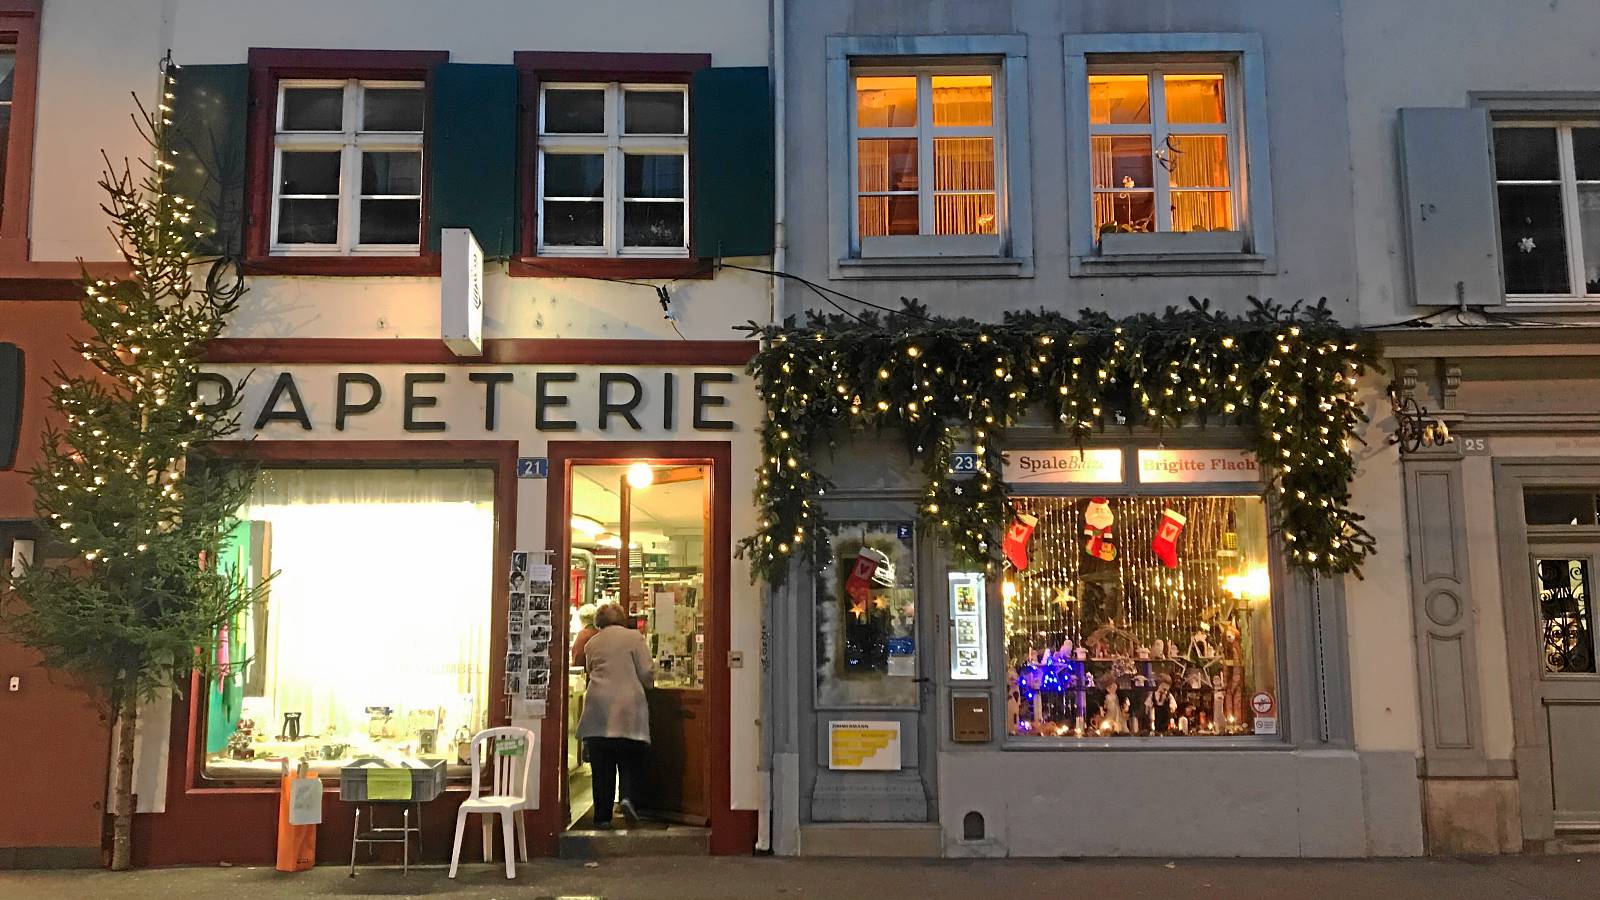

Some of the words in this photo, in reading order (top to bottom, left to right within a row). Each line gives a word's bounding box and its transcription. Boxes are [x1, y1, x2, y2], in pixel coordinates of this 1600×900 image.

[190, 371, 734, 431] PAPETERIE
[1465, 439, 1485, 451] 25
[525, 461, 540, 475] 21
[955, 456, 973, 470] 23
[1143, 459, 1205, 474] Brigitte
[1211, 458, 1257, 471] Flach
